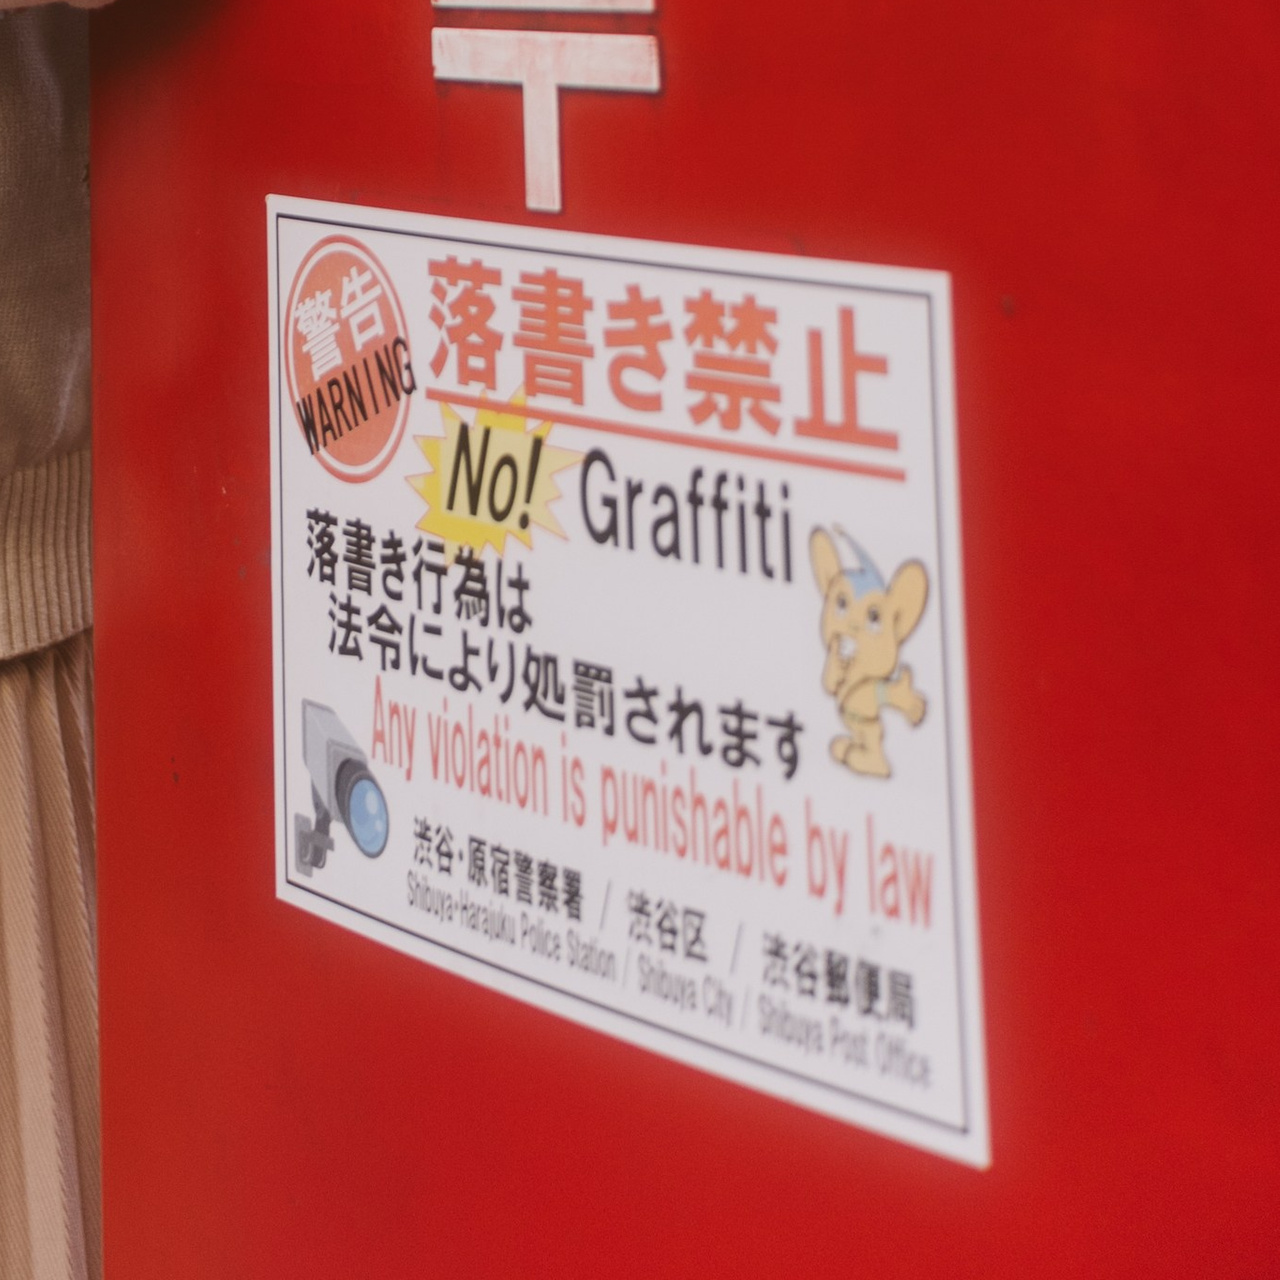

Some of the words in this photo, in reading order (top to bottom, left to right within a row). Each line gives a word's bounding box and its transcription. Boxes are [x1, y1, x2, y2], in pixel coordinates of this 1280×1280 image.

[294, 265, 387, 384] 警告
[295, 335, 418, 457] WARNING
[426, 254, 900, 452] 落書き禁止
[305, 507, 534, 634] 落書き行為は
[445, 420, 544, 530] No!
[578, 446, 794, 584] Graffiti
[326, 590, 806, 782] 法令により処罰されます
[371, 673, 417, 783] Any
[426, 695, 549, 807] violation
[560, 728, 587, 828] is
[600, 757, 789, 889] punishable
[803, 794, 850, 918] by
[864, 809, 935, 932] law
[519, 908, 562, 964] Police
[565, 927, 617, 984] Station
[636, 948, 698, 1014] Shibuya
[700, 970, 734, 1031] City
[756, 988, 826, 1058] Shibuya
[828, 1015, 870, 1070] Post
[874, 1030, 934, 1092] Office
[626, 887, 710, 965] 渋谷区
[761, 929, 917, 1032] 渋谷郵便局
